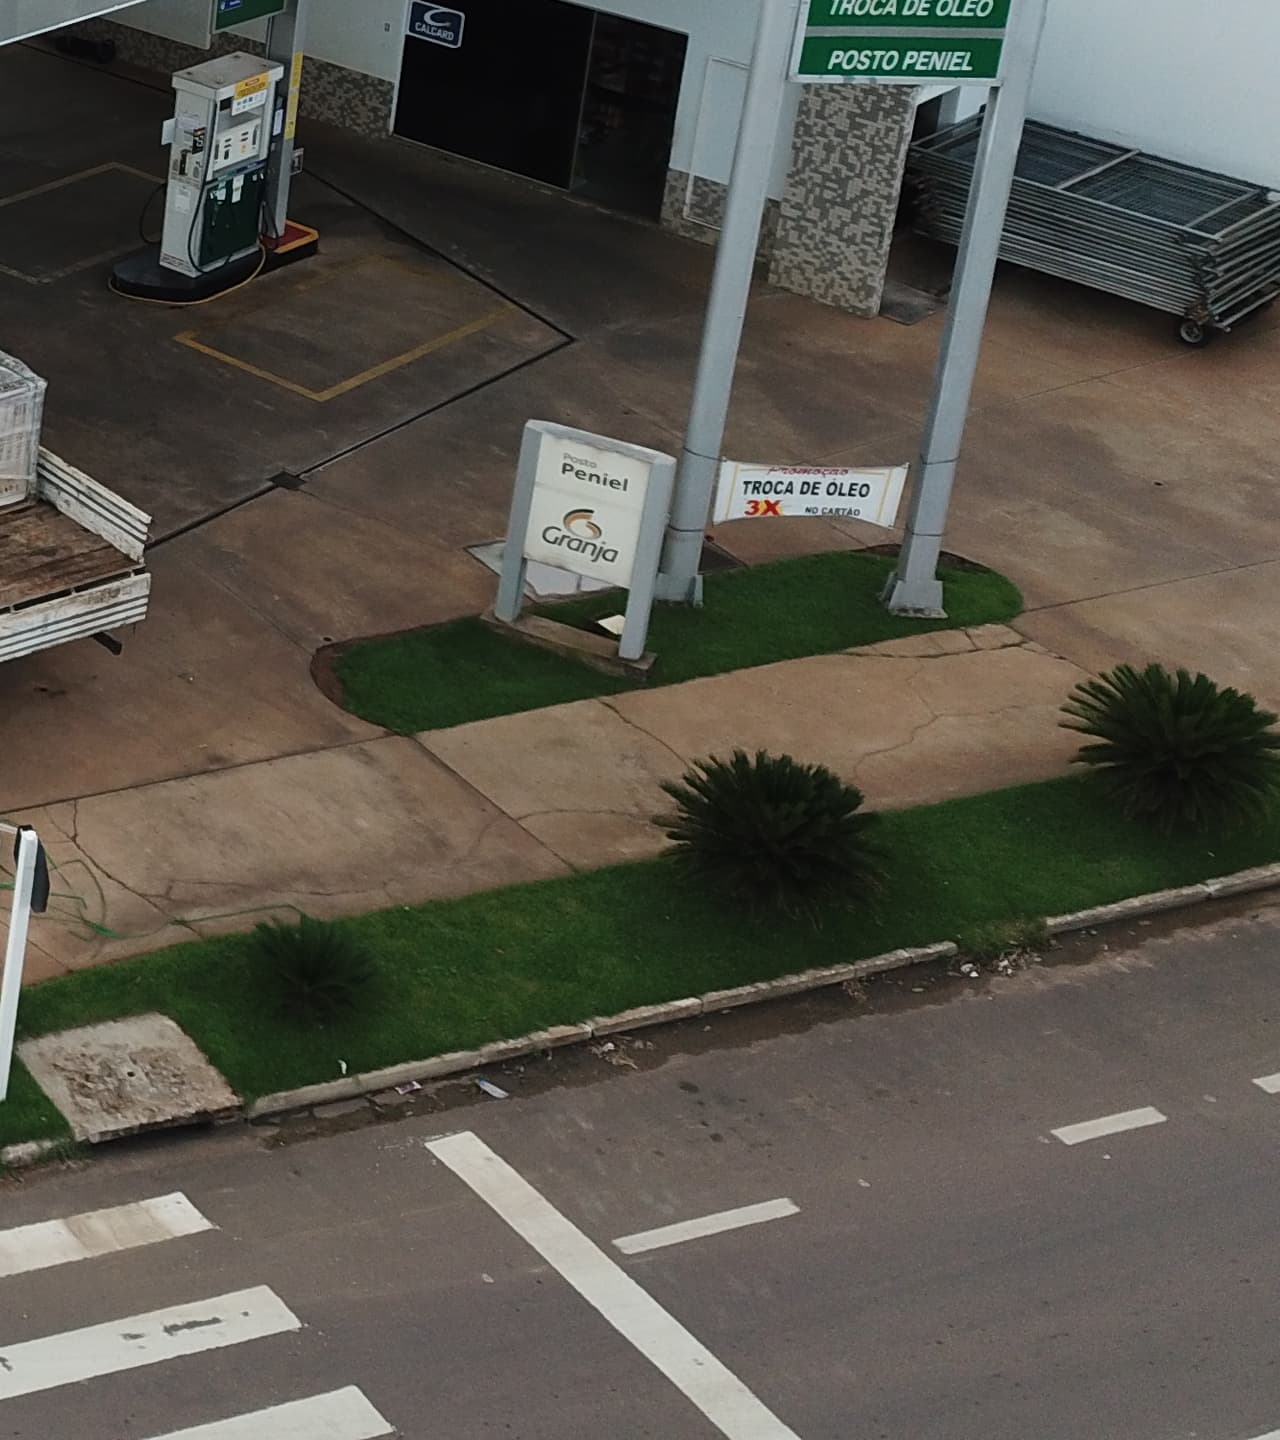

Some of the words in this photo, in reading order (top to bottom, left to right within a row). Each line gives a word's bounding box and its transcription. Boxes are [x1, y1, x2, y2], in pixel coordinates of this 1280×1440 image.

[828, 50, 900, 70] POSTO
[902, 51, 973, 71] PENIEL
[561, 462, 628, 491] Peniel
[743, 480, 794, 495] TROCA
[799, 481, 822, 496] DE
[826, 477, 870, 498] ÓLEO
[744, 500, 783, 516] 3X
[804, 506, 818, 514] NO
[542, 526, 619, 563] Granja
